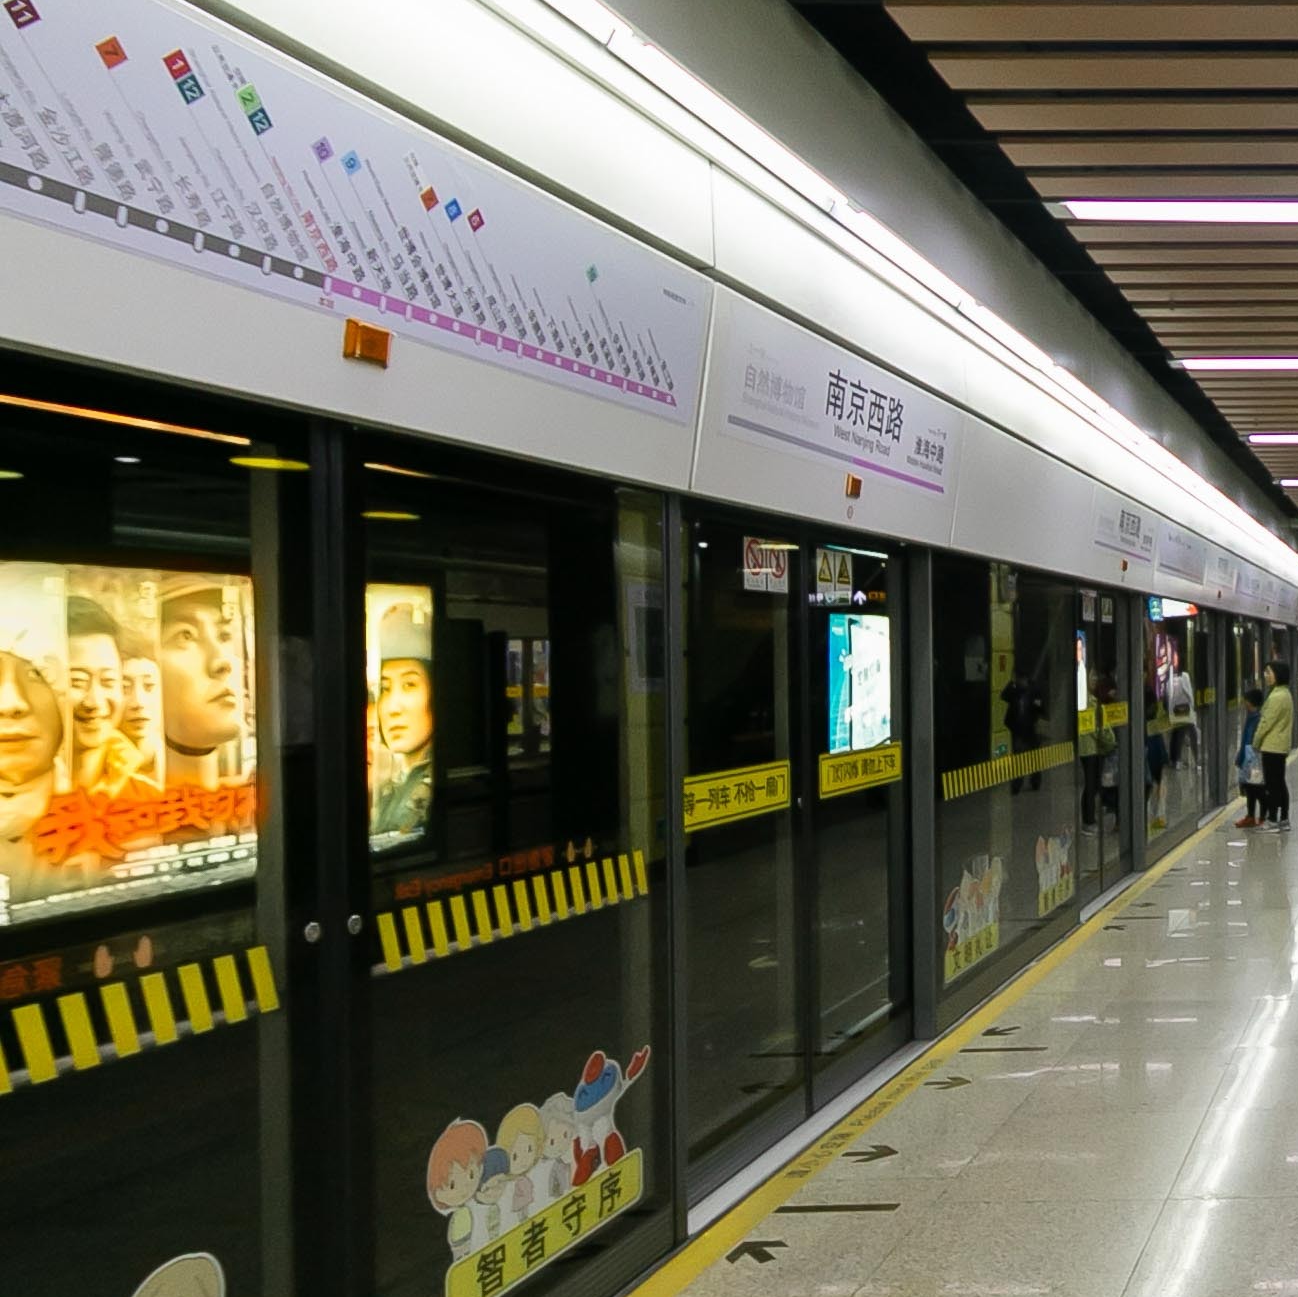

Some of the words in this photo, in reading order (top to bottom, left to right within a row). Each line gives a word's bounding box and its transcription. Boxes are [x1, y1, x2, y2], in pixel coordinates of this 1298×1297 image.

[10, 0, 34, 24] 11
[102, 44, 121, 58] 7
[170, 56, 187, 71] 1
[180, 76, 201, 101] 12
[252, 111, 273, 133] 12
[37, 106, 95, 186] 金沙江路
[825, 369, 904, 443] 南京西路
[834, 424, 850, 443] West
[851, 430, 875, 454] Nanjing
[875, 438, 891, 456] Road
